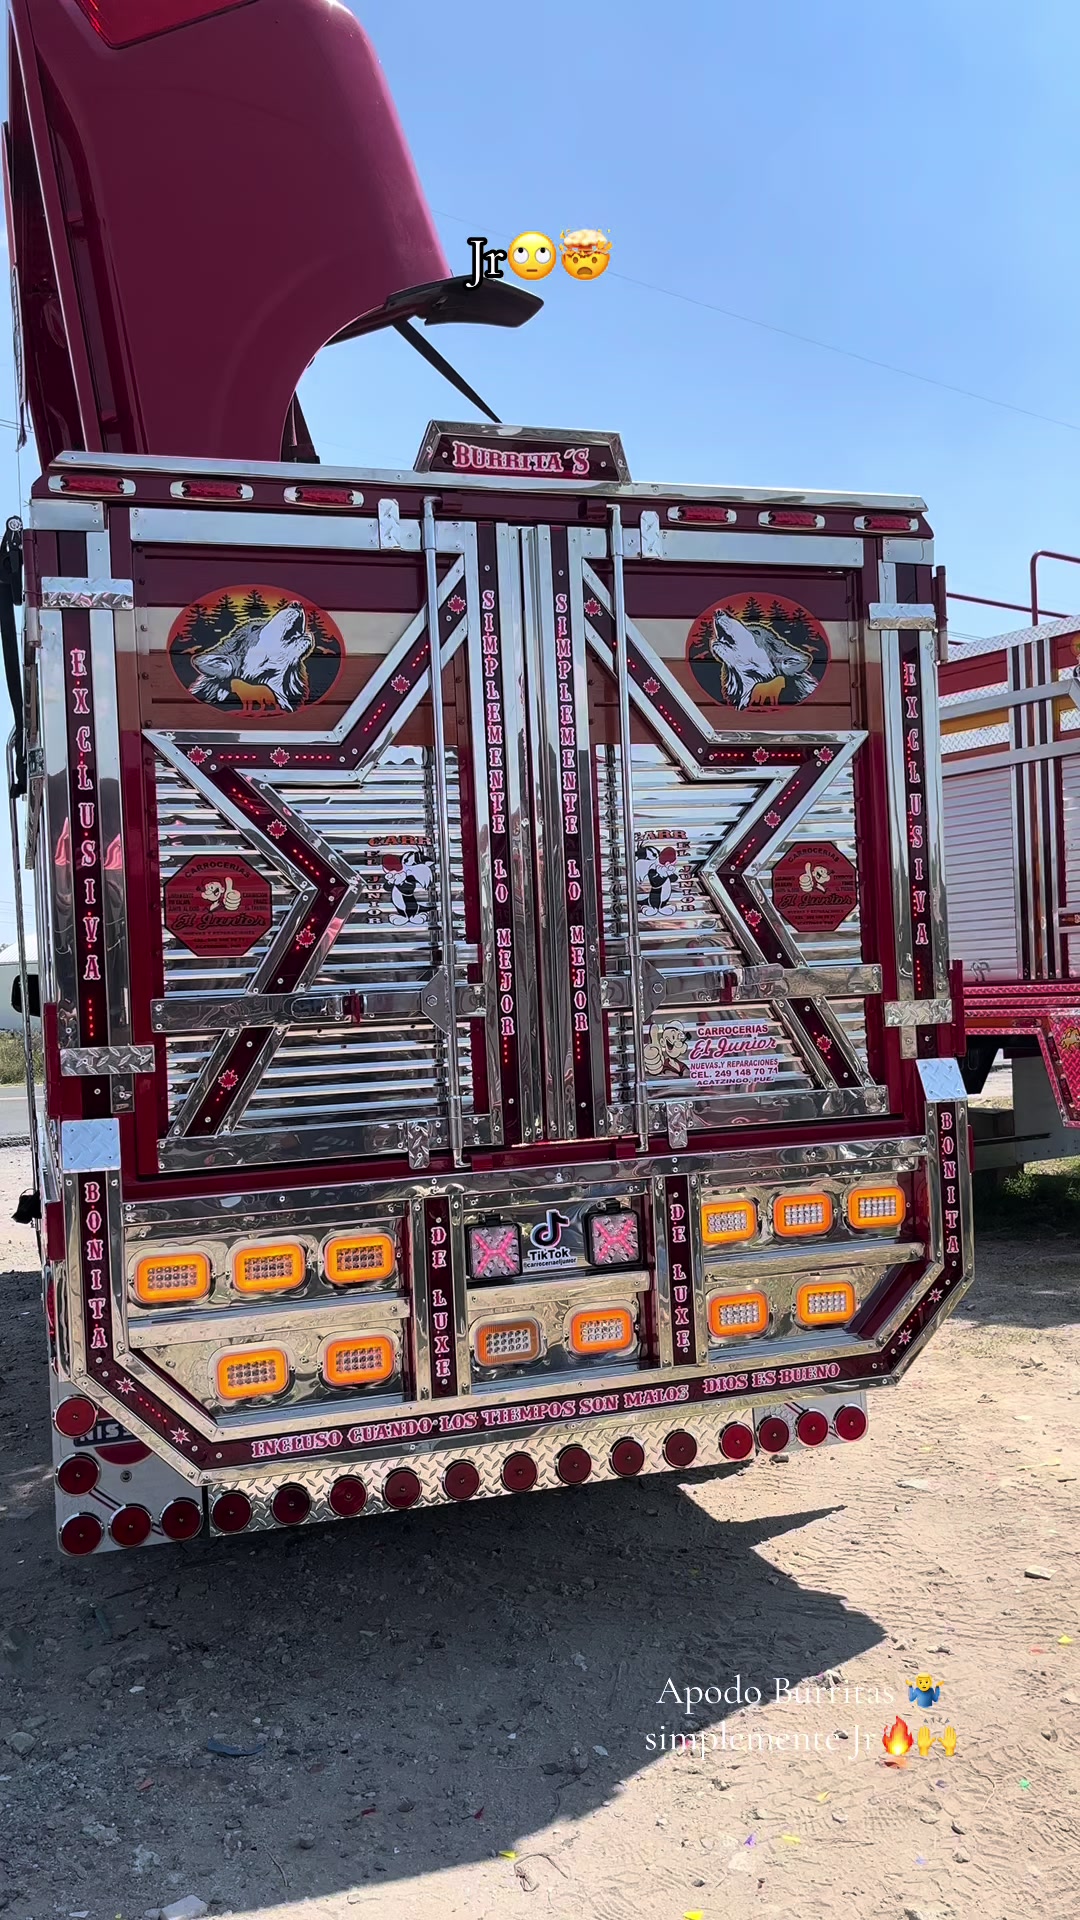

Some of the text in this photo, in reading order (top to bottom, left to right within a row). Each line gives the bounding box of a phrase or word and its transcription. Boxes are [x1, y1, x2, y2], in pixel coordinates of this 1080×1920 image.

[70, 649, 101, 981] EXCLUSIVA
[482, 590, 515, 1035] SIMPLEMENTE LO MEJOR
[556, 594, 588, 1031] SIMPLEMENTE LO MEJOR
[905, 663, 929, 945] EXCLUSIVA
[368, 835, 432, 847] CARR
[788, 847, 839, 863] CARROCERIAS
[184, 861, 251, 878] CARROCERIAS
[777, 893, 853, 910] El Junior
[171, 912, 266, 931] El Junior
[697, 1024, 769, 1036] CARROCERIAS
[689, 1036, 778, 1060] El Junior
[690, 1067, 779, 1079] CEL. 249 148 70 71
[726, 1058, 779, 1068] REPARACIONES
[941, 1112, 959, 1254] BONITA
[84, 1181, 107, 1349] BONITA
[529, 1248, 569, 1261] TikTok
[671, 1204, 690, 1348] DE LUXE
[431, 1226, 450, 1377] DE LUXE
[251, 1362, 841, 1458] INCLUSO CUANDO LOS TIEMPOS SON MALOS DIOS ES BUENO
